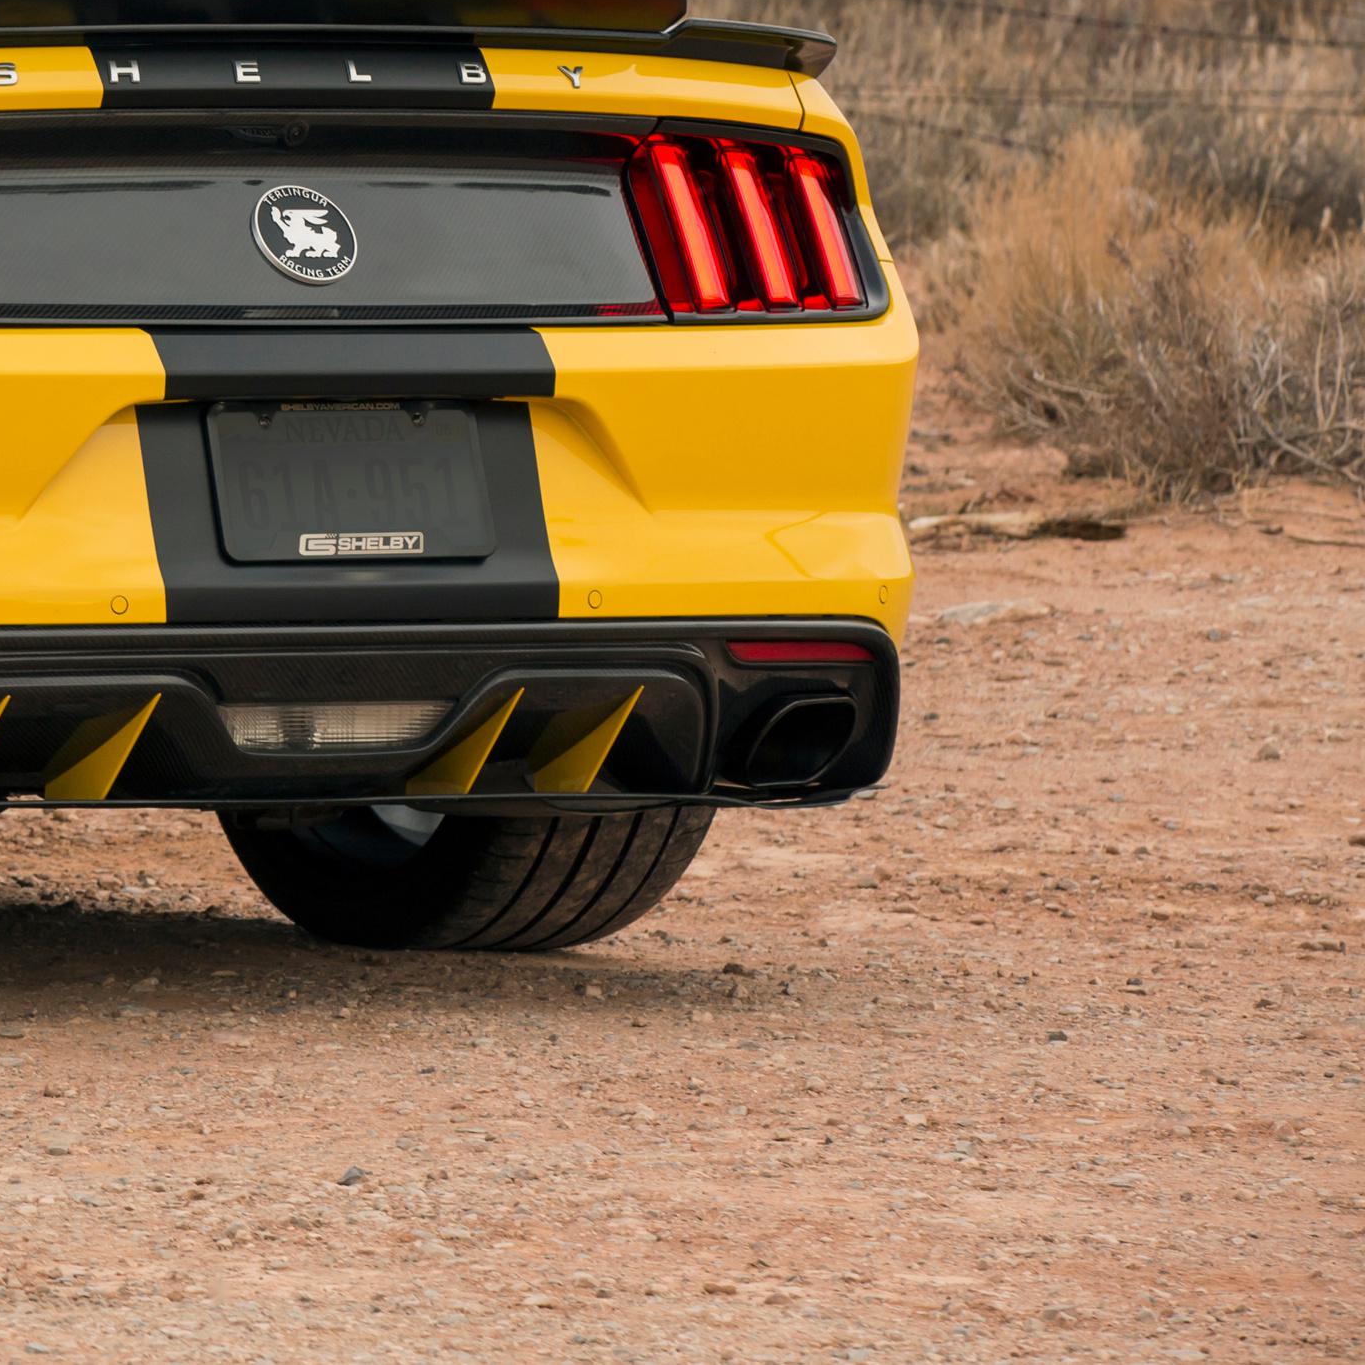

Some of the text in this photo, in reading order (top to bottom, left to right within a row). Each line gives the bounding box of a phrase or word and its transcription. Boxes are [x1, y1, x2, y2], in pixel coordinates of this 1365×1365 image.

[264, 188, 328, 207] TERLINGUA
[279, 254, 352, 278] RACING TEAM
[284, 416, 405, 445] NEVADA
[338, 536, 418, 551] SHELBY
